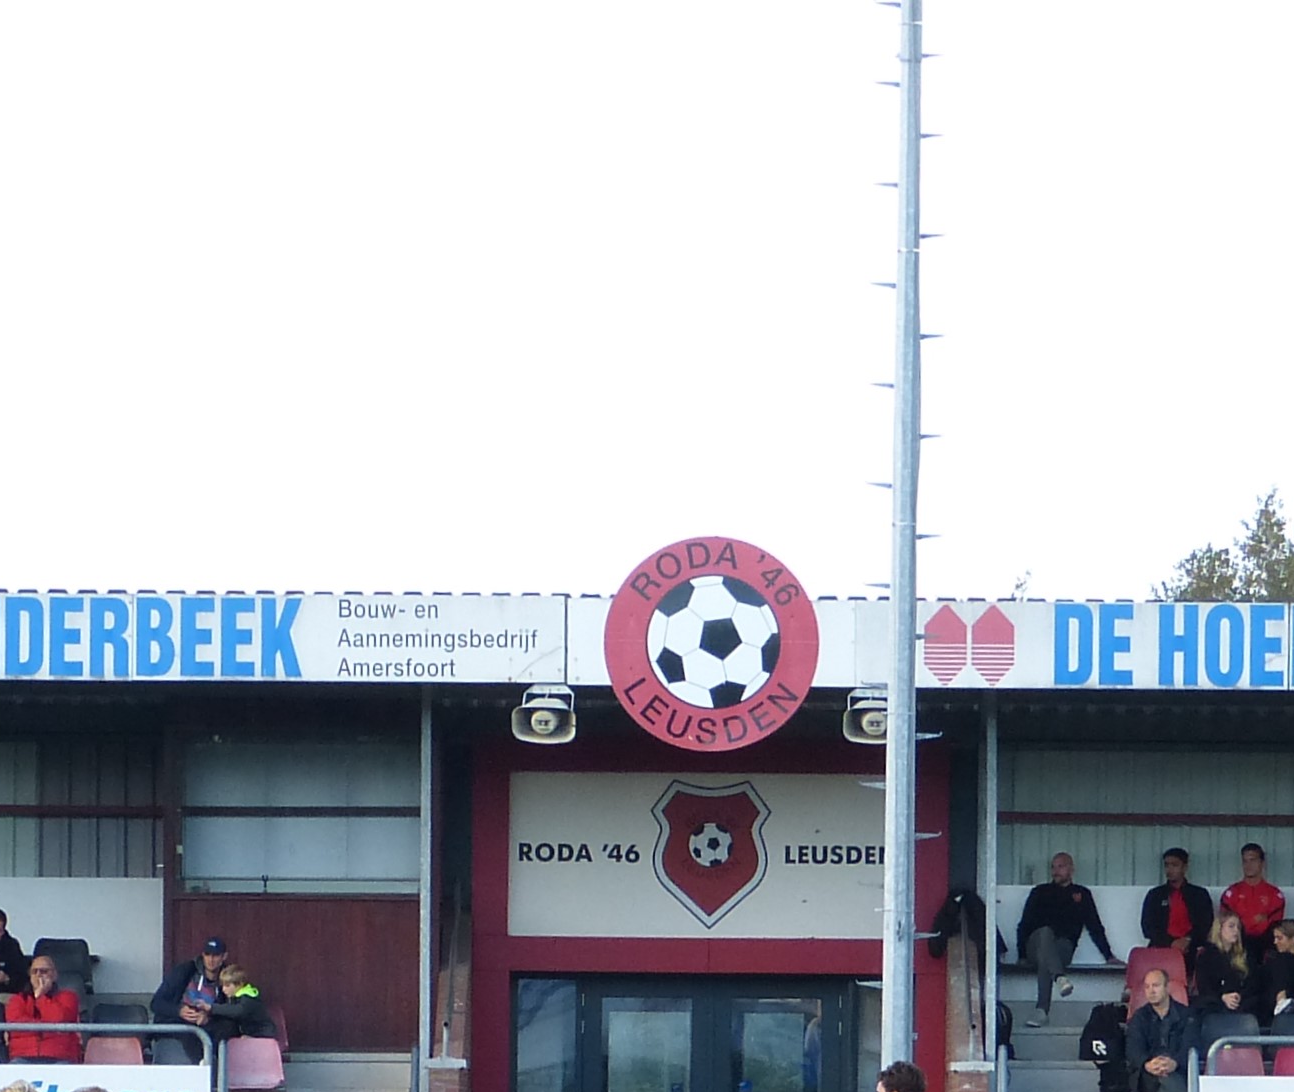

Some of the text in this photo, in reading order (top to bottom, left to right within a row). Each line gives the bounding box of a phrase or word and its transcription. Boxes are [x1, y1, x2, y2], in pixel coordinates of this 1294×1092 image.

[630, 542, 738, 600] RODA
[337, 599, 439, 619] Bouw- en
[337, 628, 538, 653] Aannemingsbedrijf
[1053, 603, 1134, 686] DE
[337, 657, 457, 678] Amersfoort
[624, 677, 799, 745] LEUSDEN
[517, 842, 641, 863] RODA '46
[783, 844, 886, 865] LEUSDE
